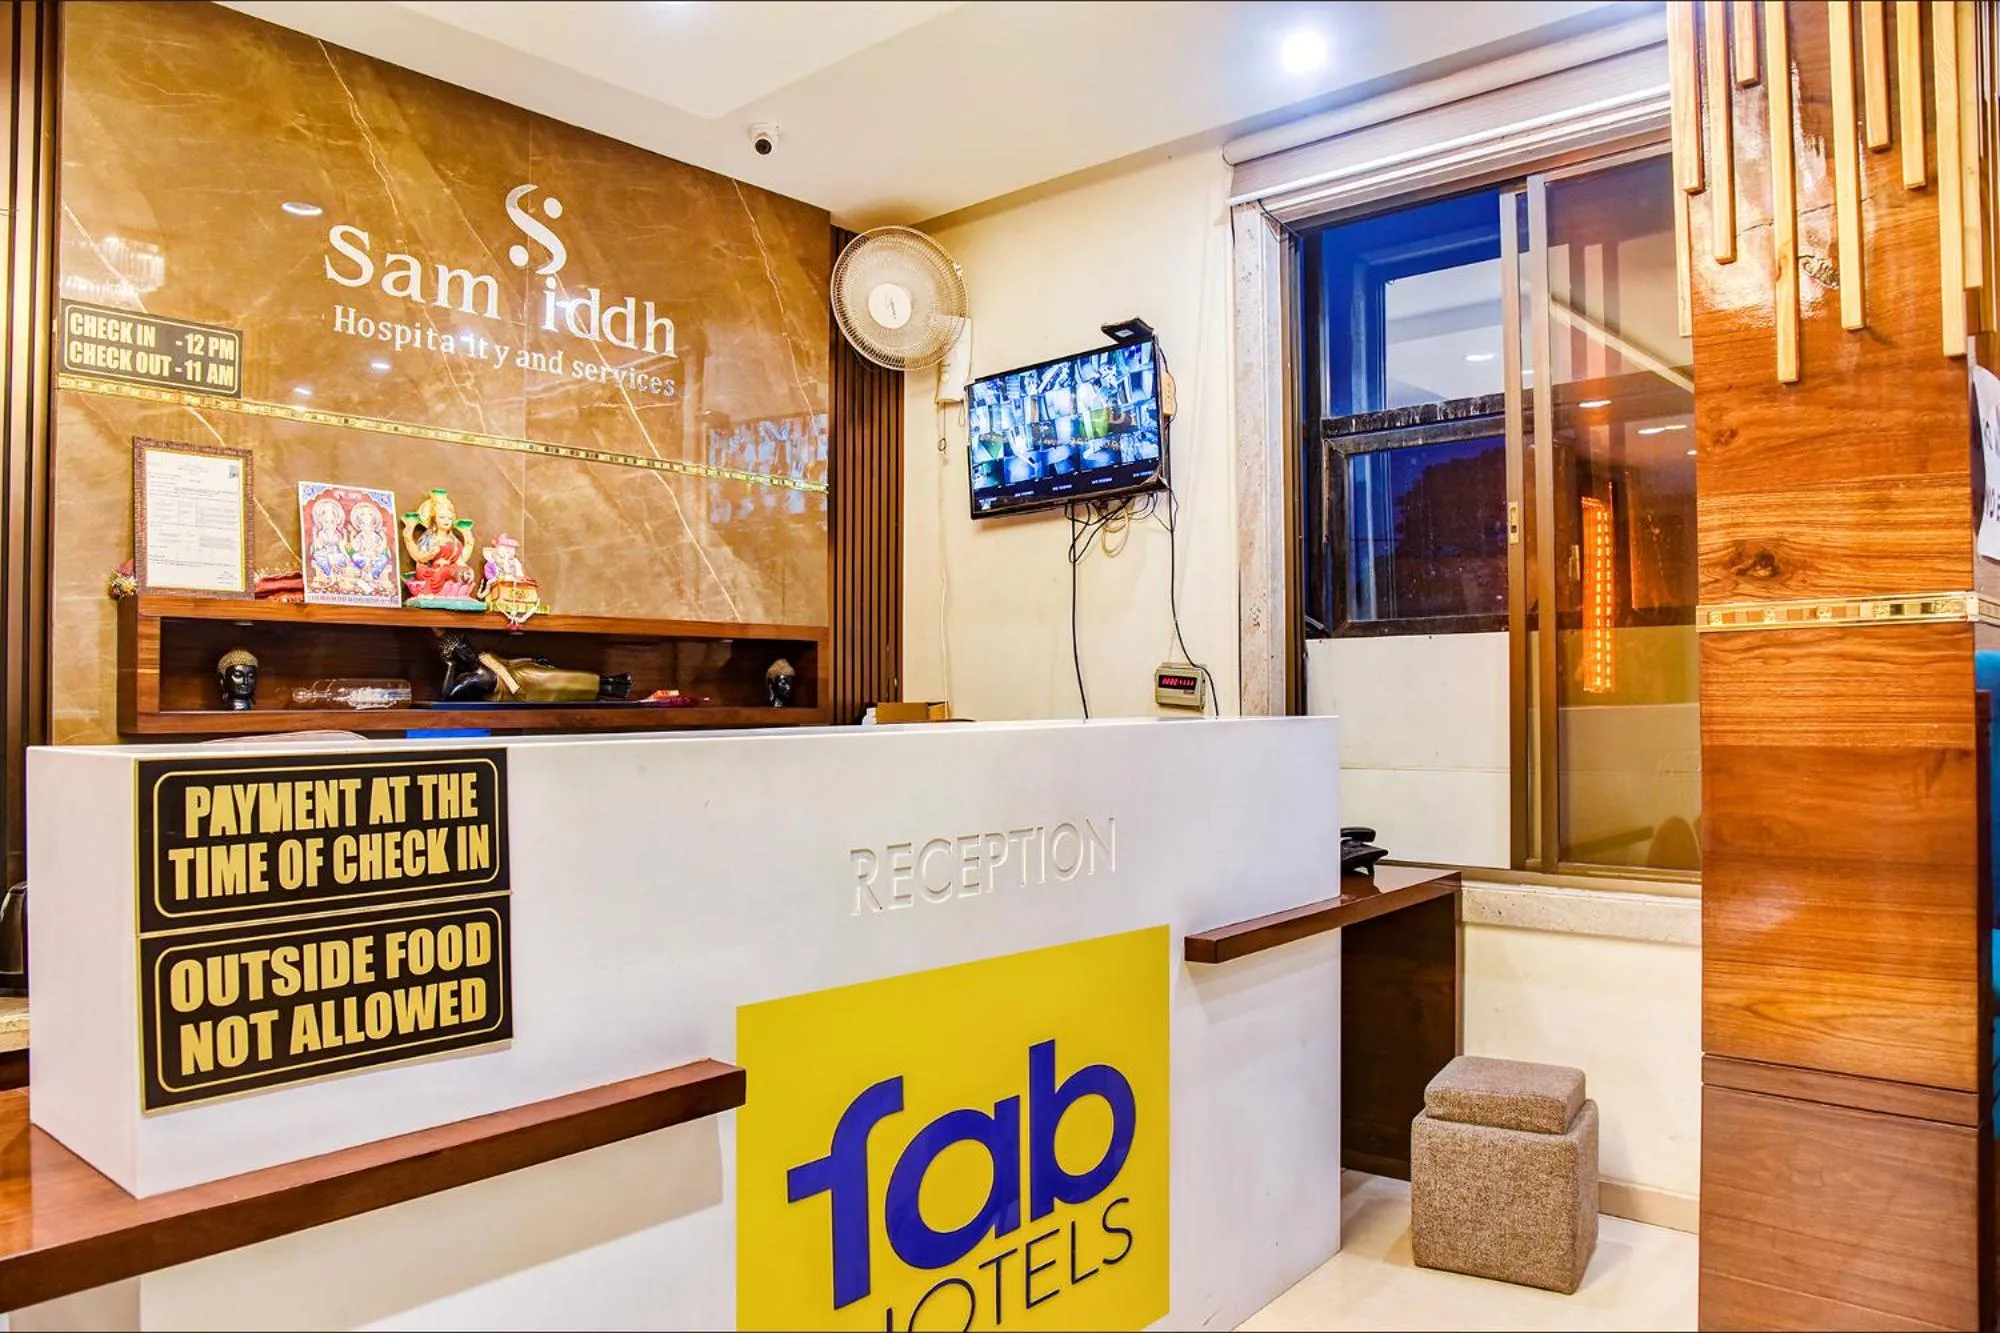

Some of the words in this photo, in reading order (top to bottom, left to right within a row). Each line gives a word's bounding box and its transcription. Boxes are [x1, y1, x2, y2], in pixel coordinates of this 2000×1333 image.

[324, 224, 501, 320] Sam
[69, 312, 134, 344] CHECK
[136, 323, 156, 347] IN
[208, 336, 235, 361] PM
[69, 340, 133, 372] CHECK
[135, 351, 173, 377] OUT
[206, 363, 234, 387] AM
[515, 349, 564, 375] and
[571, 359, 676, 396] services
[185, 778, 361, 839] PAYMENT
[369, 775, 410, 826] AT
[417, 772, 478, 821] THE
[168, 842, 269, 901] TIME
[277, 839, 324, 890] OF
[333, 828, 450, 885] CHECK
[457, 824, 490, 871] IN
[850, 817, 1116, 917] RECEPTION
[170, 936, 376, 1013] OUTSIDE
[386, 921, 491, 980] FOOD
[179, 1010, 279, 1076] NOT
[289, 977, 487, 1056] ALLOWED
[786, 1038, 1136, 1311] fab
